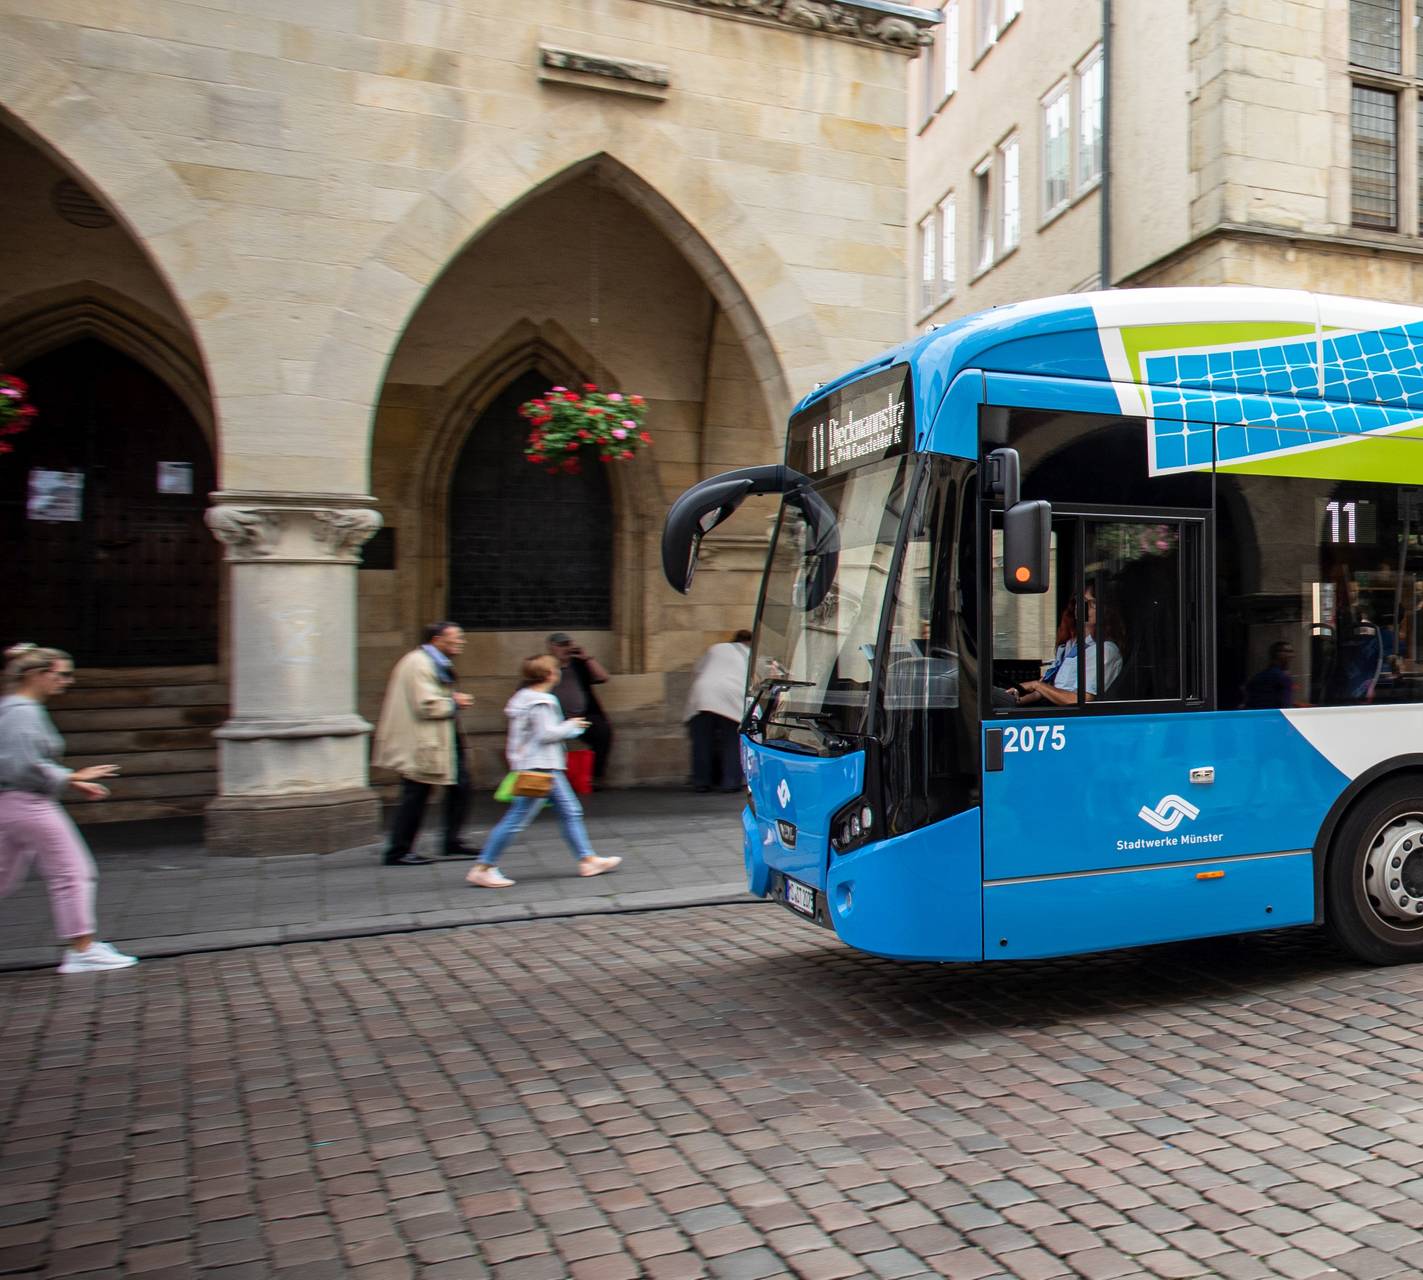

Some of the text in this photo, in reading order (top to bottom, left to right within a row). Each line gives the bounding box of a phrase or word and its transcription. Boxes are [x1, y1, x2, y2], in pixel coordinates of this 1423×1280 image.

[812, 423, 824, 472] 11
[1326, 502, 1356, 543] 11
[1003, 725, 1066, 752] 2075
[1116, 832, 1224, 851] Stadtwerke Münster
